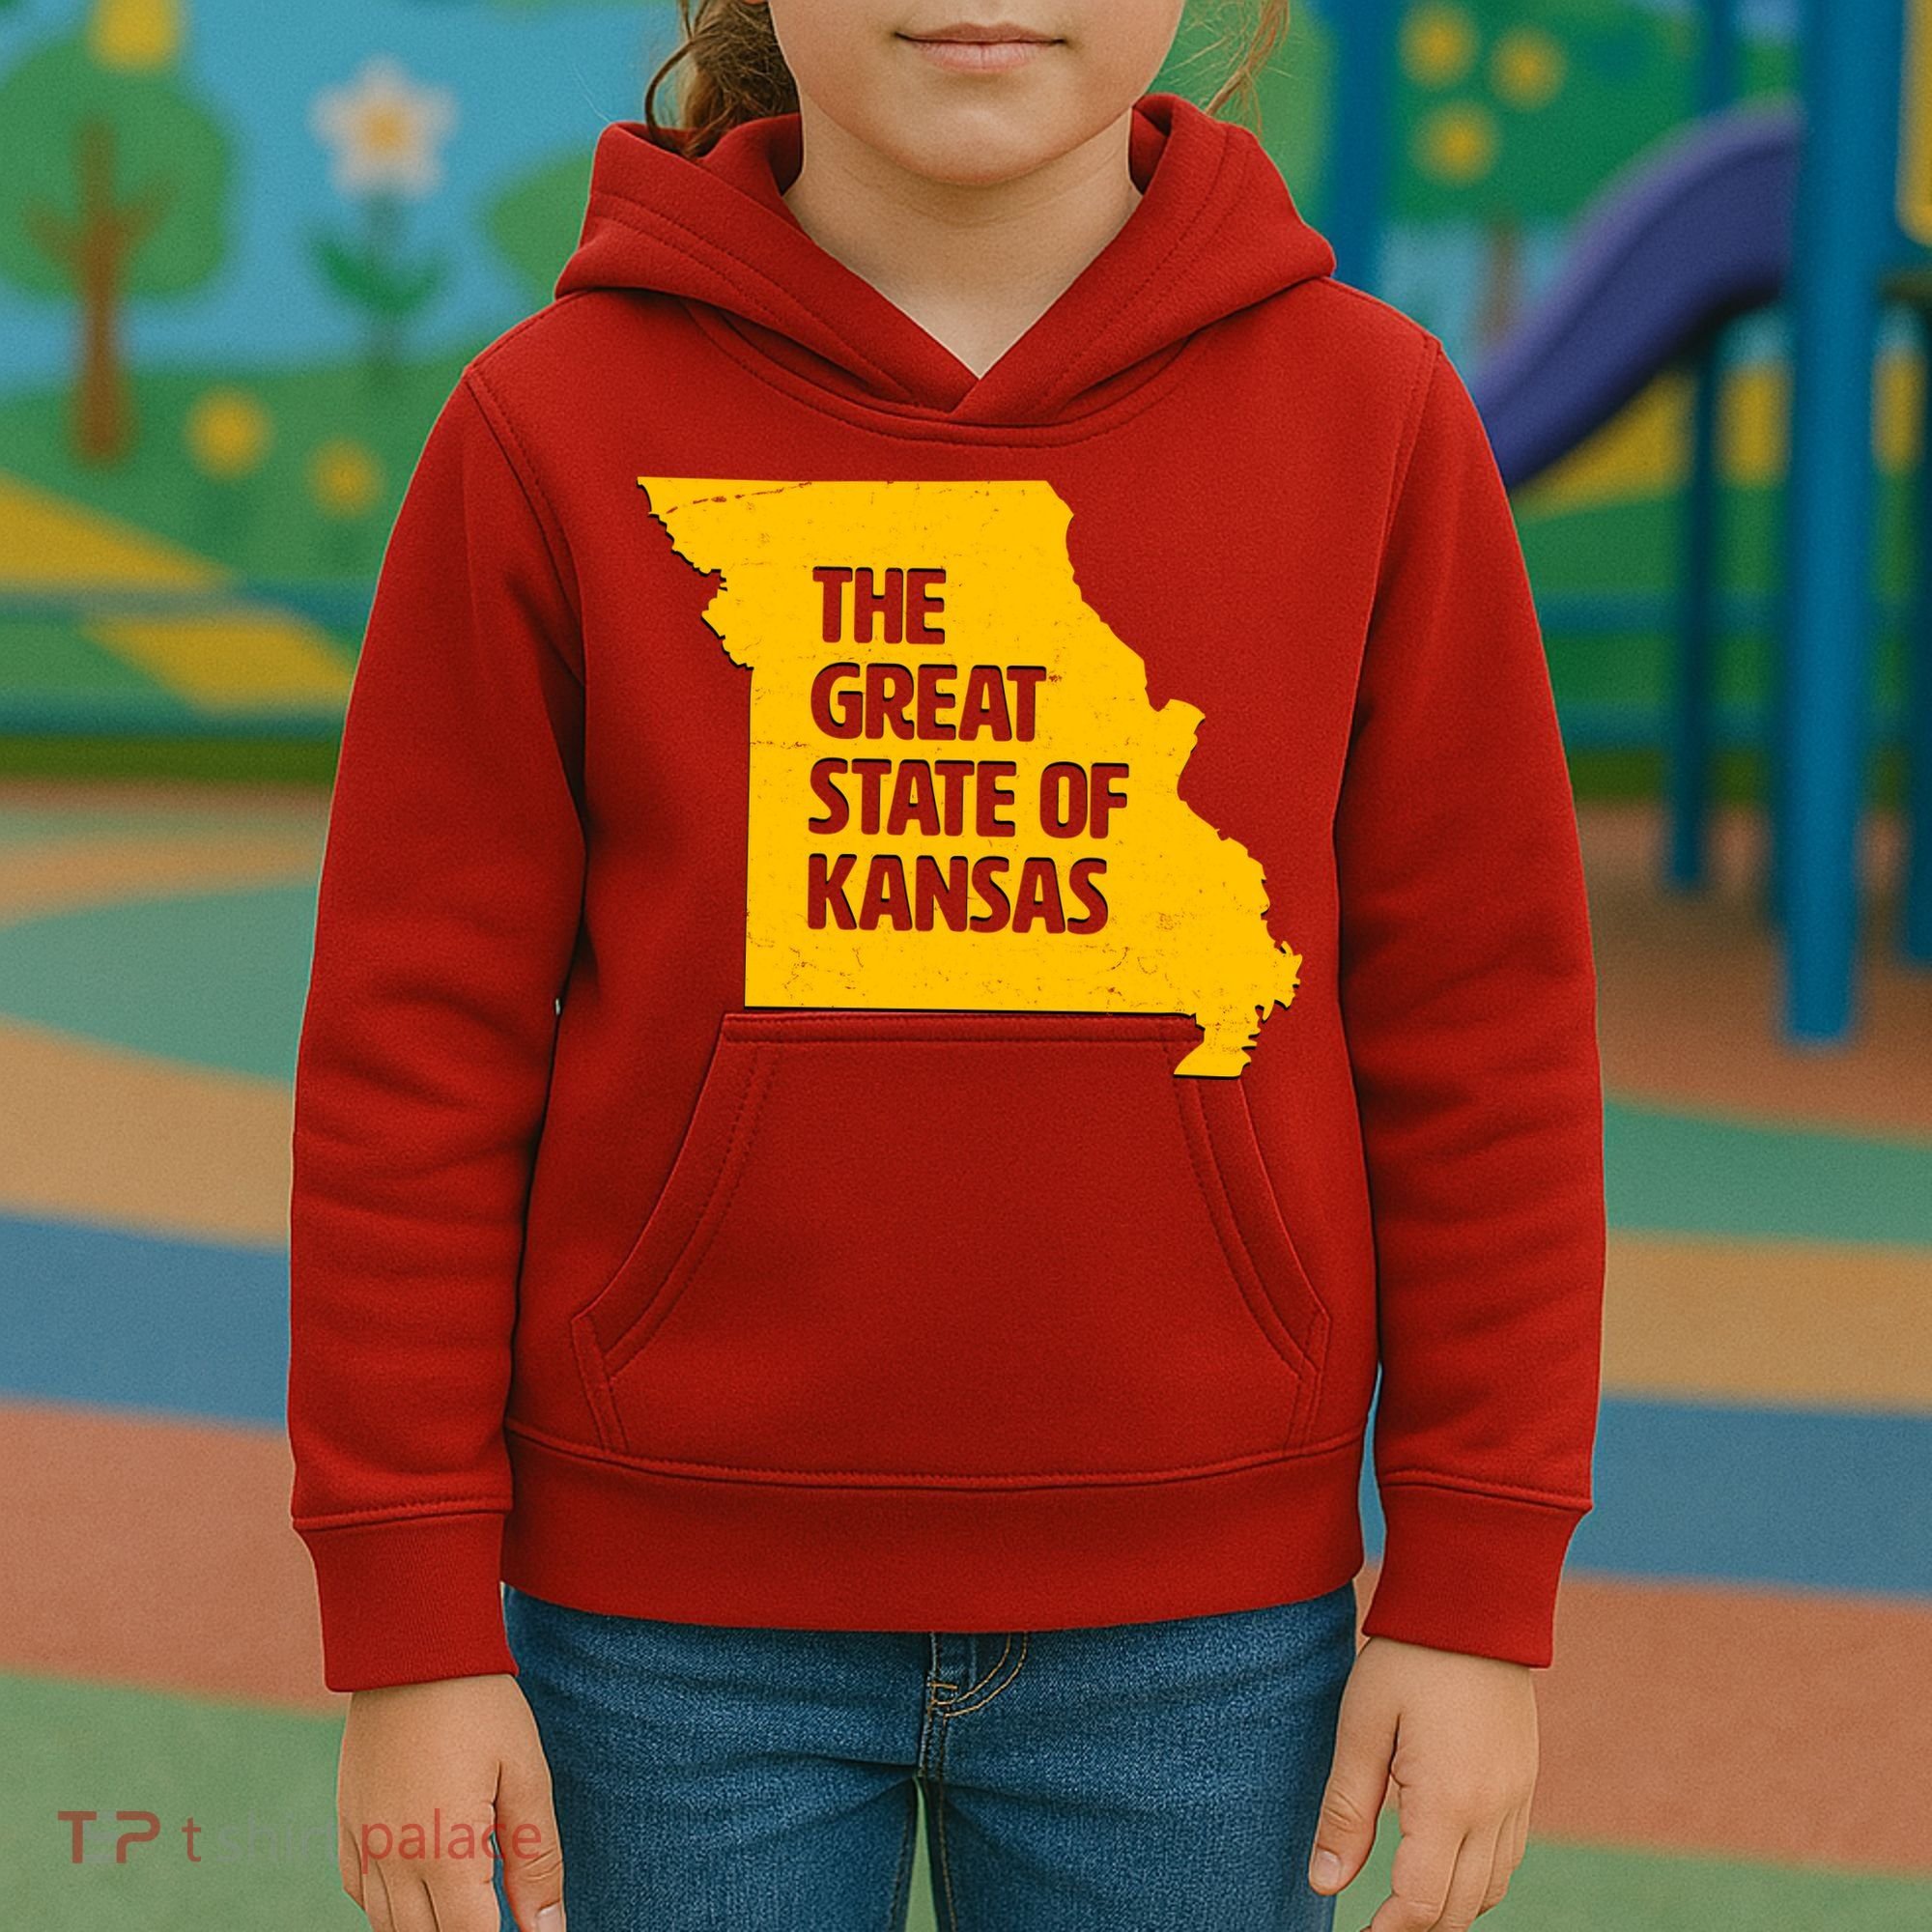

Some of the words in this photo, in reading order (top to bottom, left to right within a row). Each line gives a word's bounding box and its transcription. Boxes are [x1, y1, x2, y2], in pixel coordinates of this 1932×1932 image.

[812, 566, 947, 645] THE
[810, 662, 1047, 742] GREAT
[809, 757, 1017, 838] STATE
[1039, 761, 1129, 839] OF
[808, 853, 1109, 935] KANSAS
